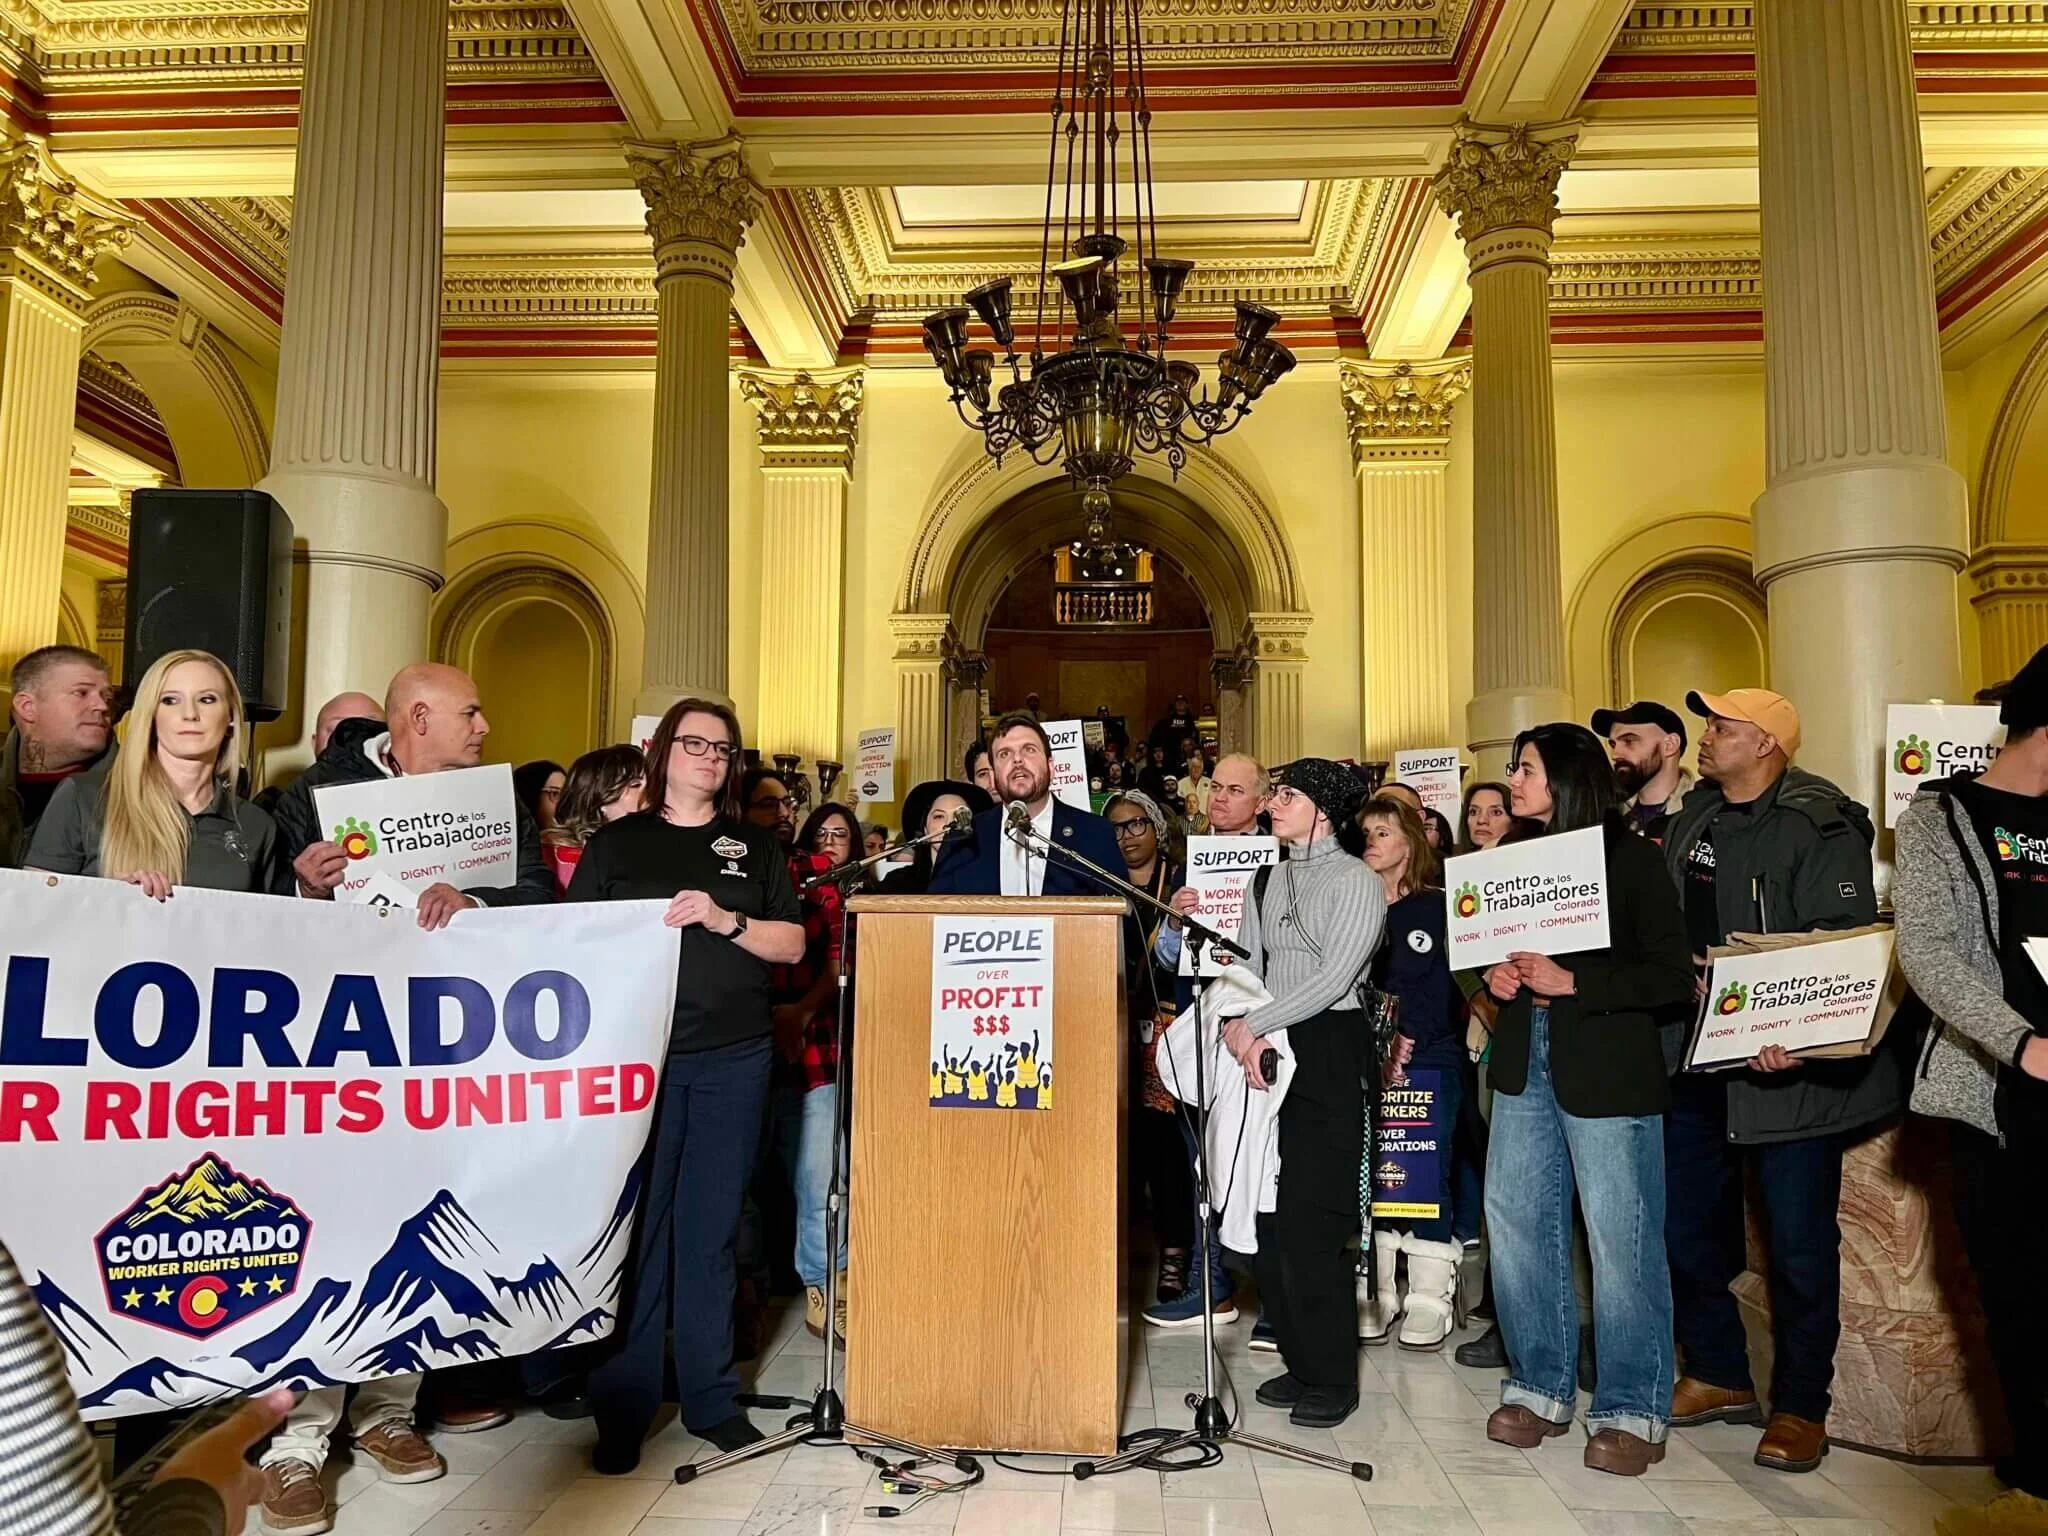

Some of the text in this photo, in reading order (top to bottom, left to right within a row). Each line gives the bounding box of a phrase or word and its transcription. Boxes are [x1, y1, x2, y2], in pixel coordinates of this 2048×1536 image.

[1047, 731, 1078, 745] PORT
[1937, 741, 2002, 760] Centr
[1054, 763, 1071, 773] KER
[1400, 756, 1456, 772] SUPPORT
[1051, 774, 1084, 786] CTION
[1415, 783, 1447, 793] ORKER
[1421, 793, 1458, 802] ECTION
[1894, 792, 1913, 801] WO
[379, 812, 486, 835] Centro de los
[381, 820, 511, 854] Trabajadores
[471, 837, 512, 852] Colorado
[2016, 833, 2048, 850] Cen
[1193, 849, 1274, 866] SUPPORT
[343, 851, 512, 891] WO DIGNITY COMMUNITY
[1224, 877, 1241, 885] THE
[1484, 874, 1572, 896] Centro de los
[1205, 888, 1247, 899] WORK
[1484, 882, 1600, 913] Trabajadores
[1195, 903, 1244, 915] ROTECT
[1554, 897, 1601, 912] Colorado
[1216, 918, 1241, 929] ACT
[1455, 912, 1600, 943] WORK DIGNITY COMMUNITY
[943, 929, 1044, 954] PEOPLE
[1415, 936, 1425, 948] 7
[976, 970, 1009, 980] OVER
[1753, 973, 1851, 996] Centro de los
[941, 985, 1044, 1010] PROFIT
[1750, 979, 1877, 1011] Trabajadores
[1823, 993, 1873, 1007] Colorado
[0, 955, 592, 1069] LORADO
[972, 1014, 1010, 1036] $$$
[1706, 1006, 1869, 1039] WORK DIGNITY COMMUNITY
[84, 1080, 385, 1141] RIGHTS
[404, 1062, 656, 1130] UNITED
[1381, 1090, 1434, 1103] ORITIZE
[1380, 1105, 1428, 1119] RKERS
[1378, 1140, 1437, 1152] ORATIONS
[106, 1223, 300, 1263] COLORADO
[108, 1252, 299, 1280] WORKER RIGHTS UNITED
